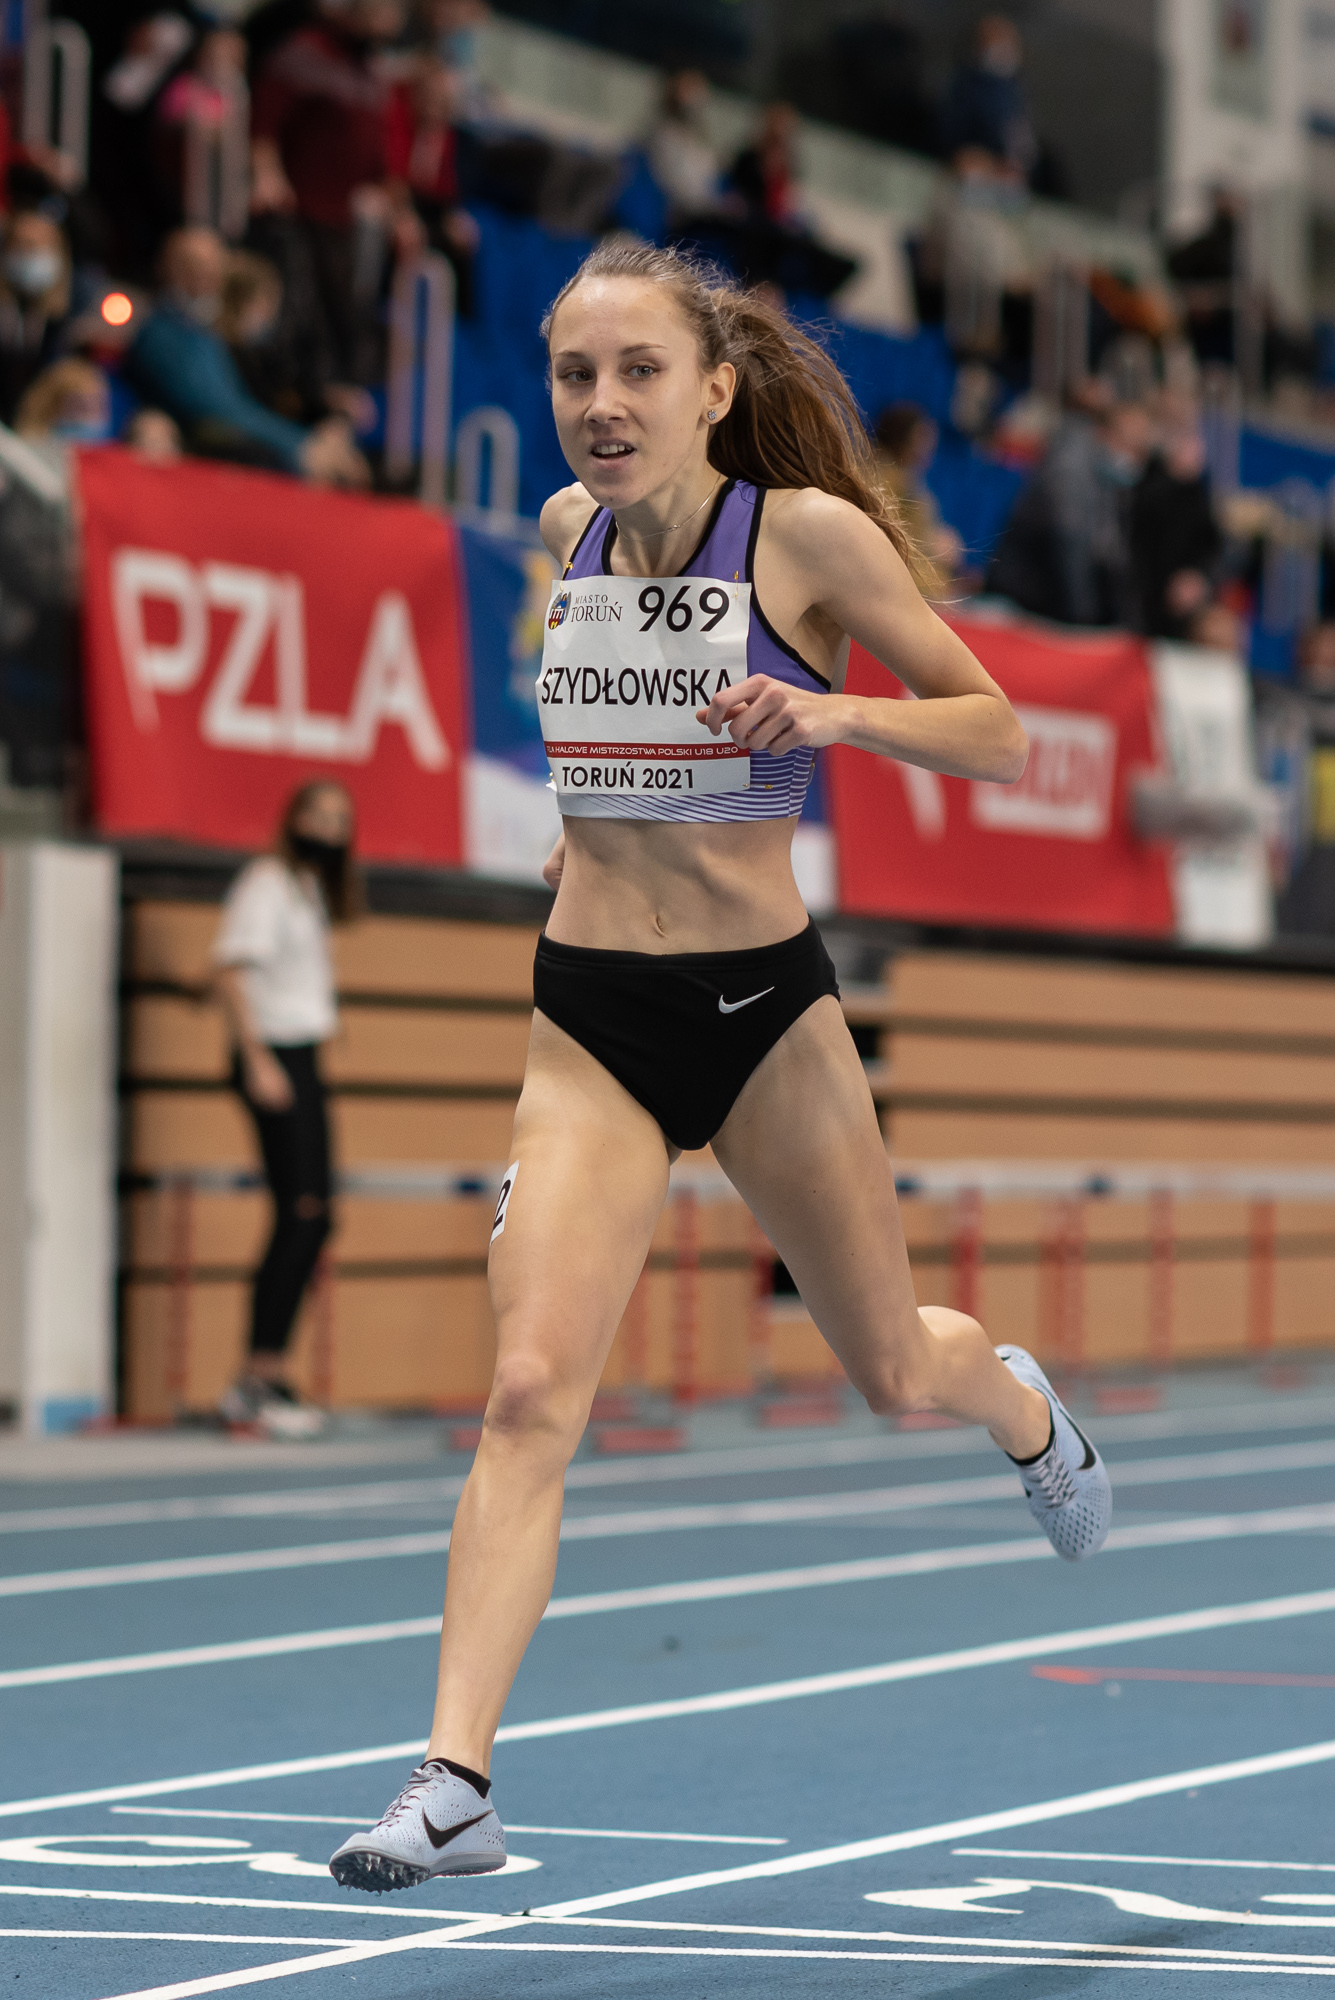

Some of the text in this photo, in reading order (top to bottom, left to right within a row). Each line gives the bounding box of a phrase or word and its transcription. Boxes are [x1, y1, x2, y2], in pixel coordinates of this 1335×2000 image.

[571, 602, 624, 622] TORUŃ
[575, 594, 609, 604] MIASTO
[638, 585, 730, 633] 969
[110, 546, 451, 772] PZLA
[541, 667, 732, 706] SZYDŁOWSKA
[555, 746, 588, 754] HALOWE
[589, 747, 657, 755] MISTRZOSTWA
[658, 748, 692, 756] POLSKI
[694, 748, 714, 756] U18
[716, 746, 739, 755] U20
[562, 761, 694, 789] TORUŃ 2021
[493, 1179, 511, 1231] 2
